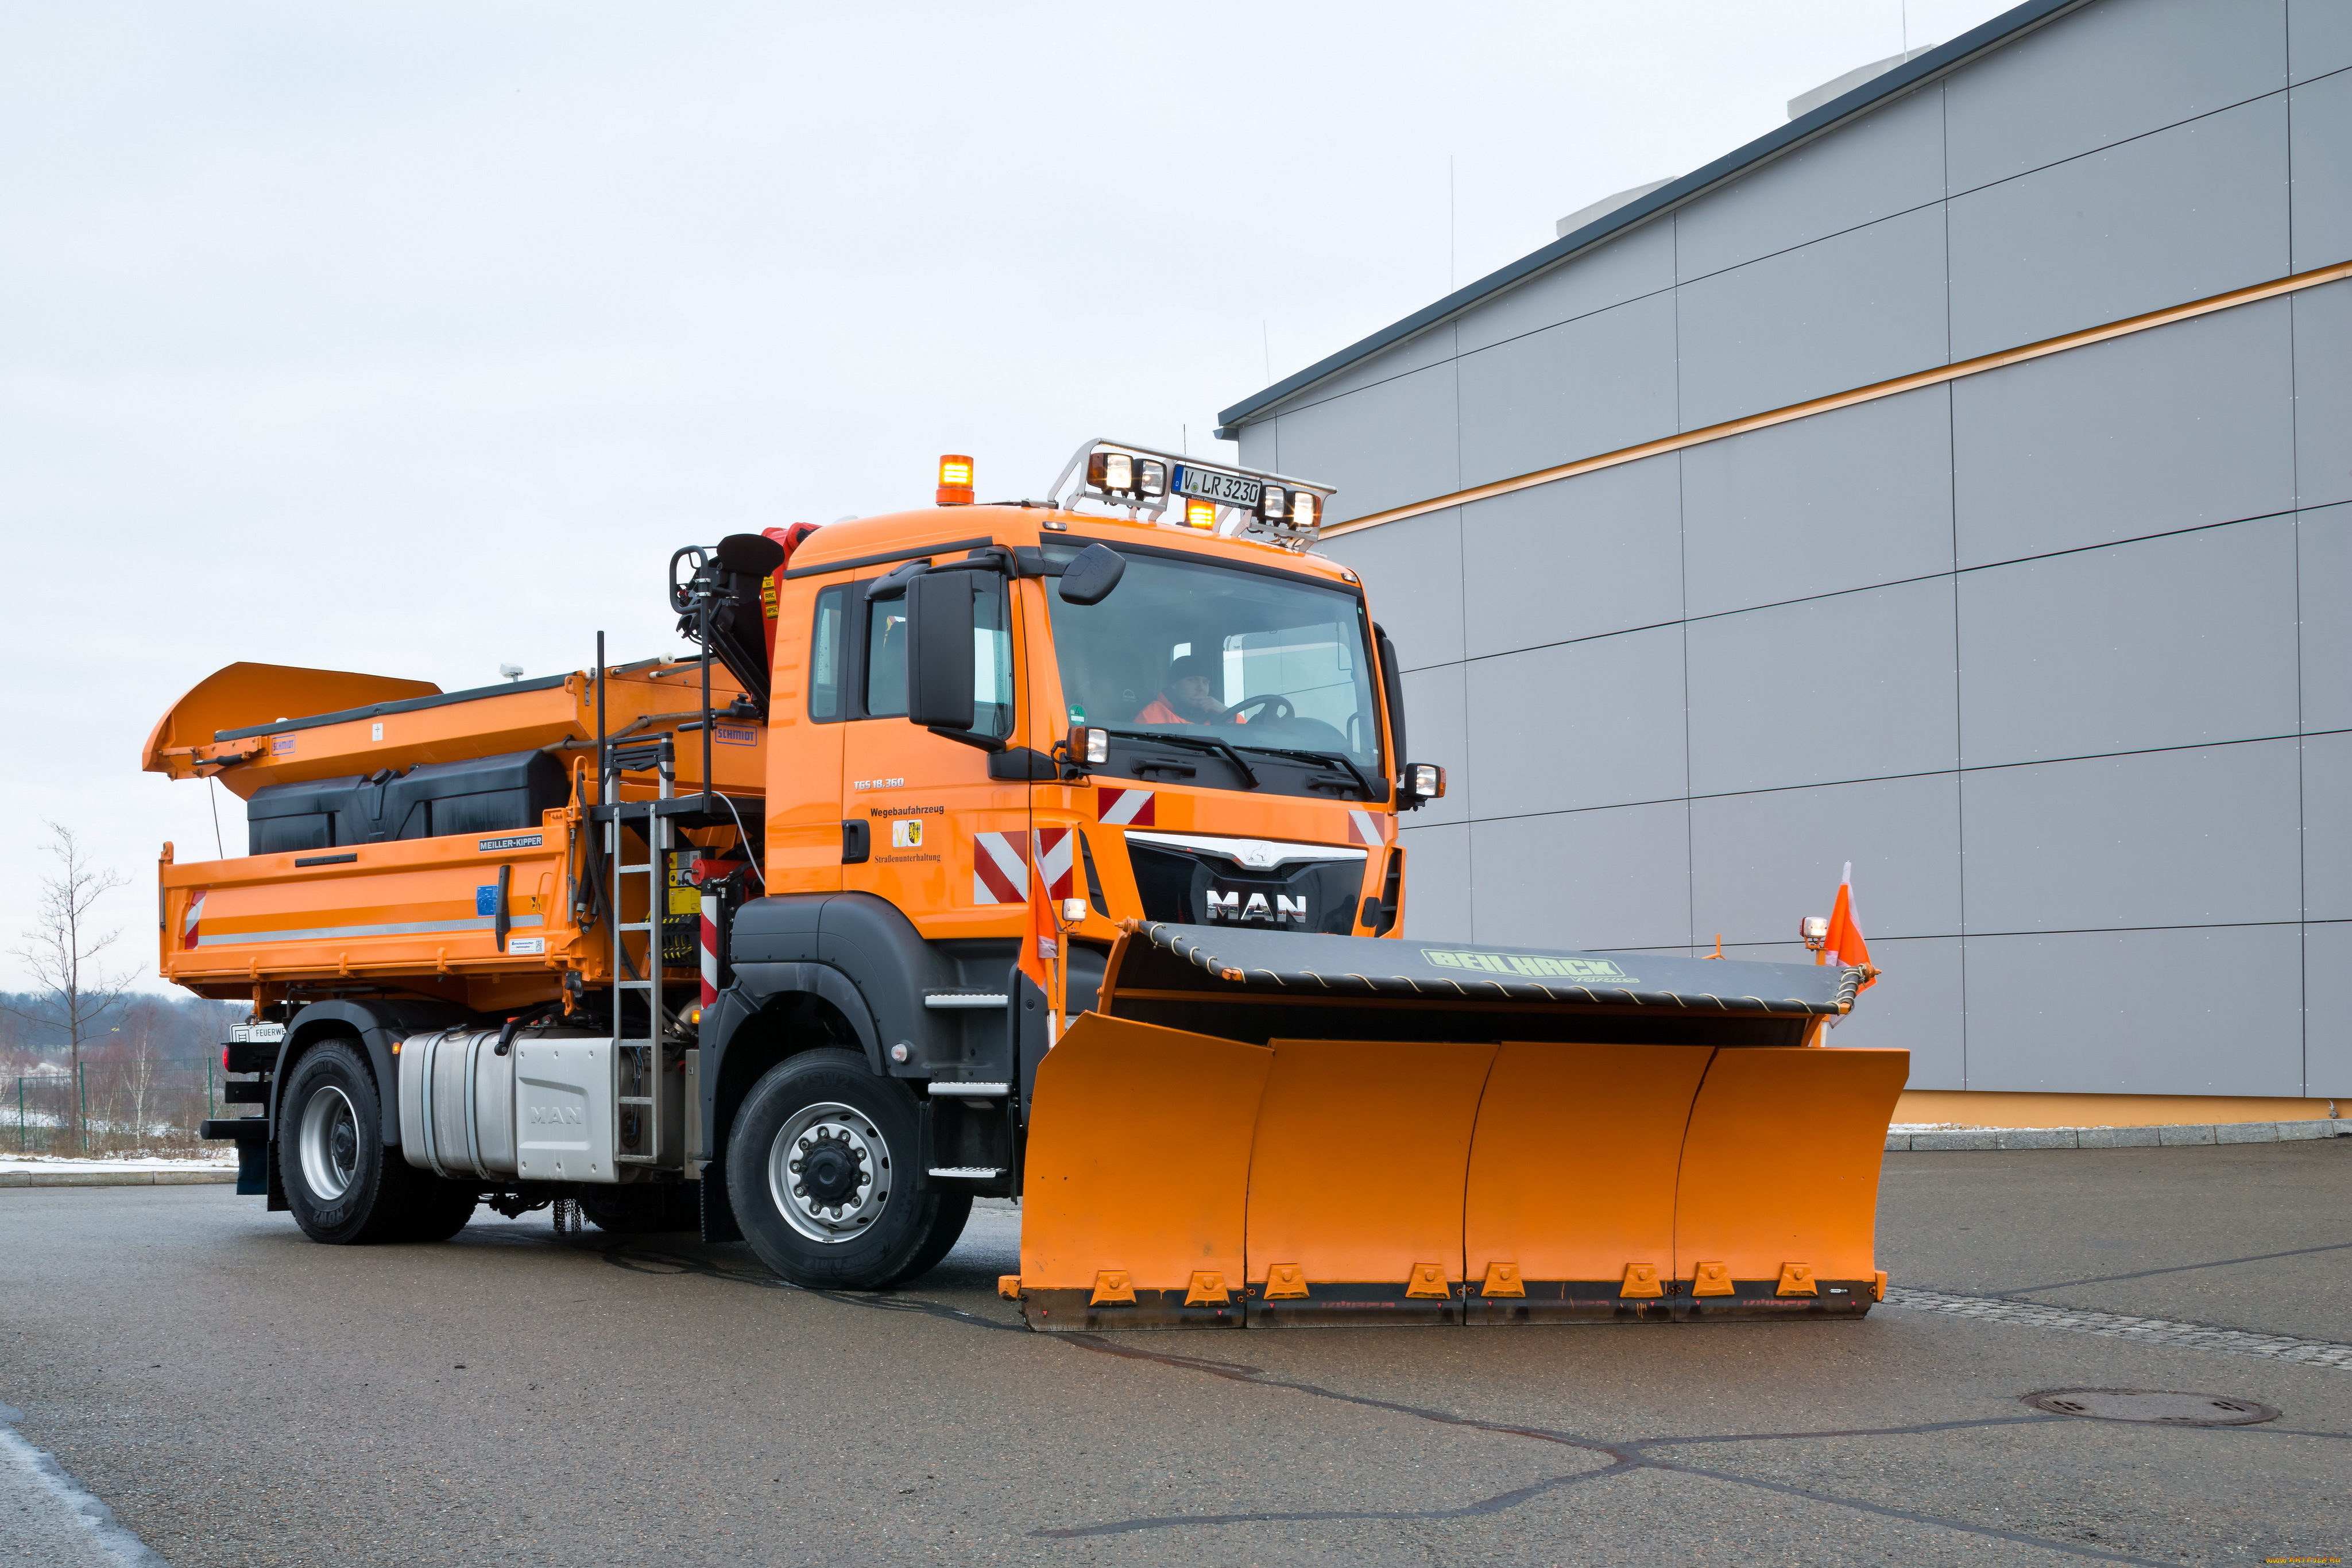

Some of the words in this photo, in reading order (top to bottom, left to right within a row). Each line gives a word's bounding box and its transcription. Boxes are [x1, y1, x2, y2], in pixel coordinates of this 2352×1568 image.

[1185, 470, 1194, 490] V
[1201, 474, 1221, 495] LR
[1223, 479, 1259, 503] 3230
[1075, 707, 1080, 716] 4
[718, 729, 754, 741] SCHMIDT
[273, 740, 294, 751] SCHMIDT
[854, 781, 871, 790] TGS
[873, 778, 904, 788] 18.360
[871, 805, 944, 818] Wegebaufahrzeug
[480, 837, 541, 850] MEILLER-KIPPER
[875, 853, 941, 864] Straßenunterhaltung
[1206, 890, 1306, 923] MAN
[1428, 951, 1618, 976] BEILHACK
[256, 1028, 285, 1037] FEUERWE
[795, 1071, 851, 1091] HSW2
[531, 1107, 581, 1124] MAN
[313, 1205, 344, 1224] HDW2
